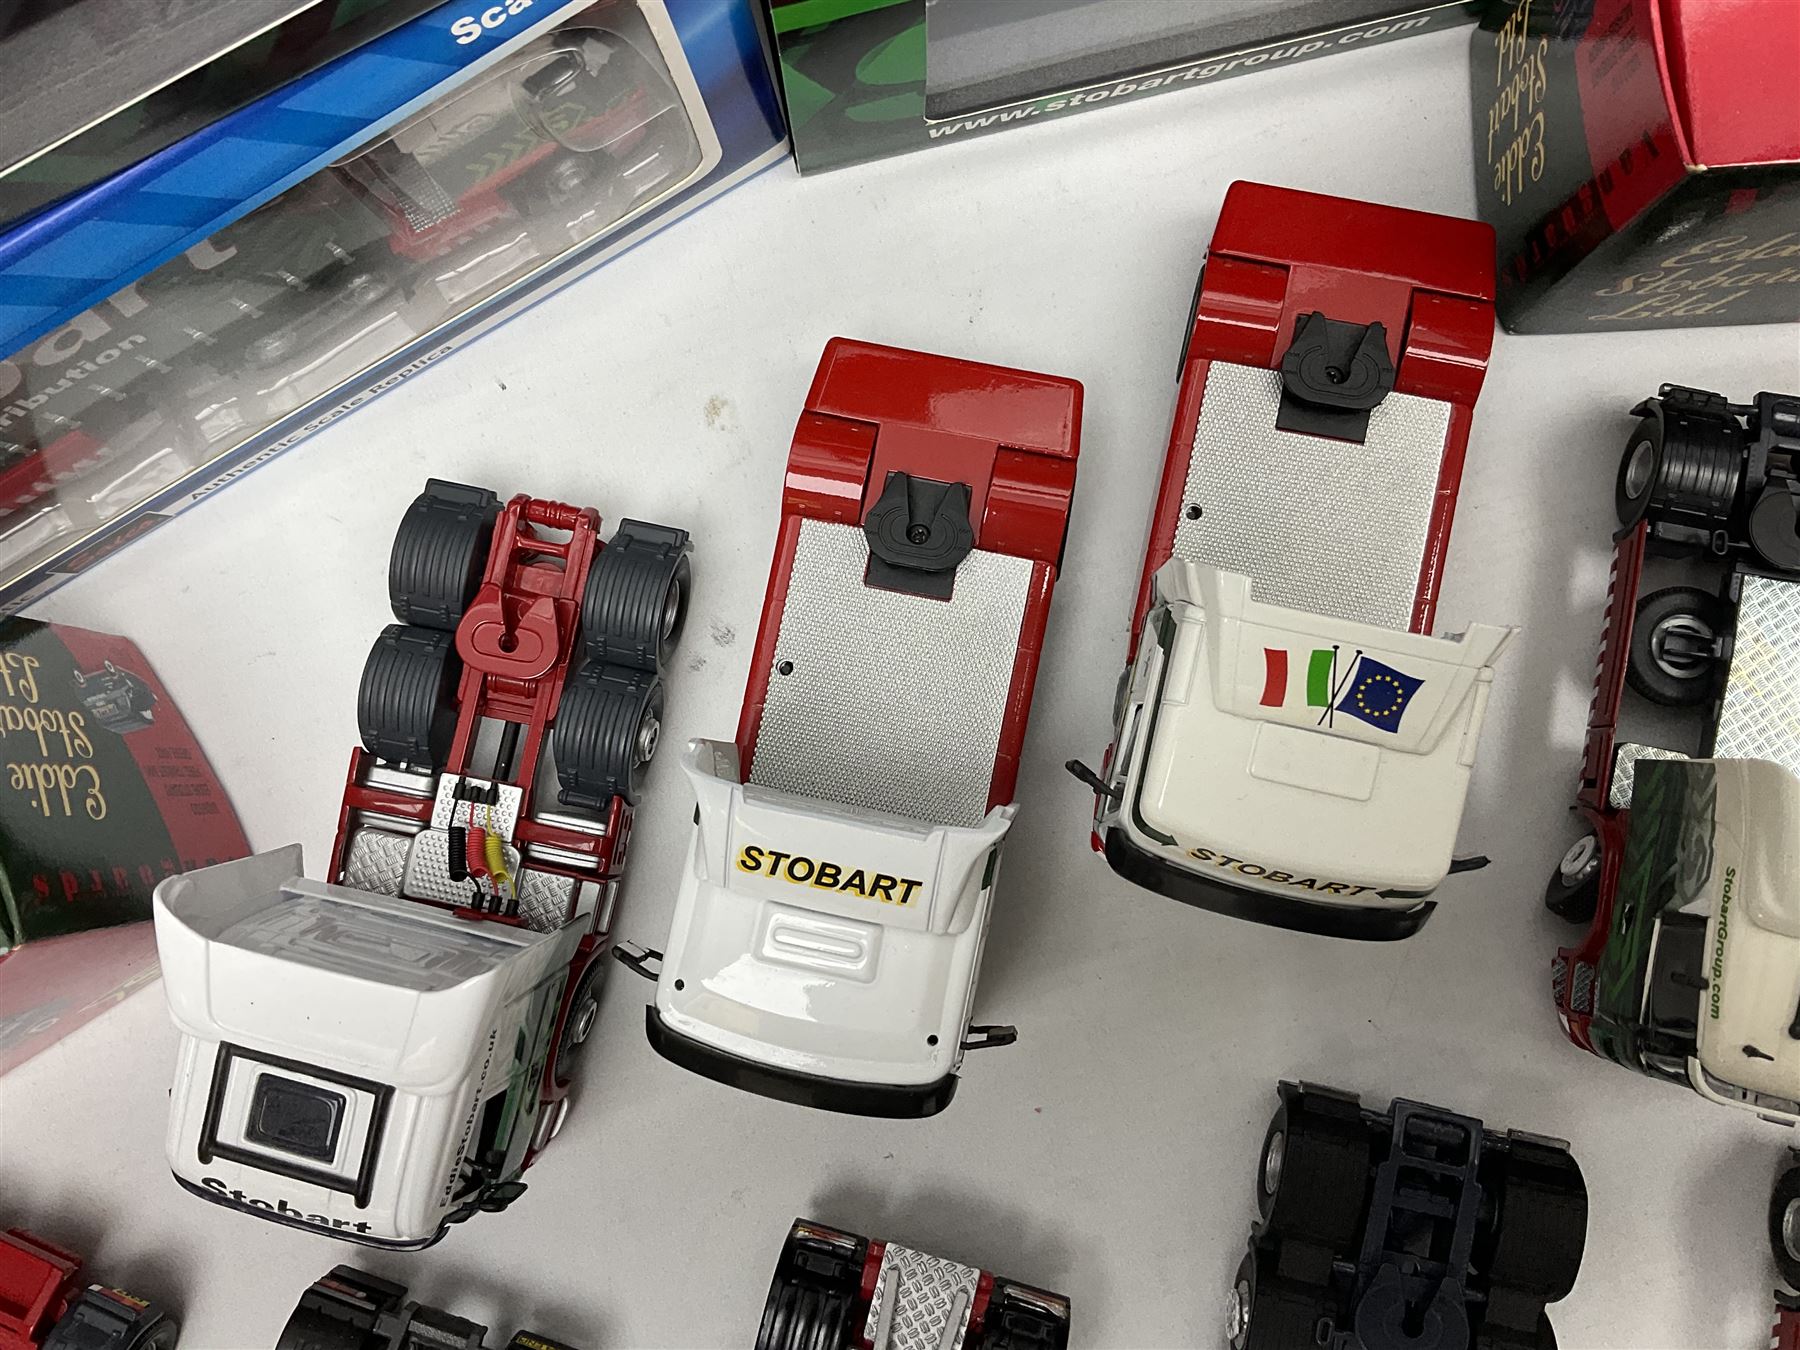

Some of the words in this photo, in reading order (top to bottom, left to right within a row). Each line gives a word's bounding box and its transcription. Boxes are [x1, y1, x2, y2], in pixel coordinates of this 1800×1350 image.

[928, 14, 1431, 140] www.stobartgroup.com
[1488, 38, 1548, 165] Stobart
[1494, 111, 1545, 206] Eddie
[1588, 289, 1750, 321] Ltd.
[0, 334, 147, 431] ribution
[191, 433, 301, 500] Authentic
[303, 397, 364, 433] Scale
[369, 344, 453, 394] Replica
[7, 764, 107, 820] Eddie
[739, 844, 924, 905] STOBART
[1190, 847, 1378, 897] STOBART
[1710, 866, 1736, 1020] StobartGroup.com
